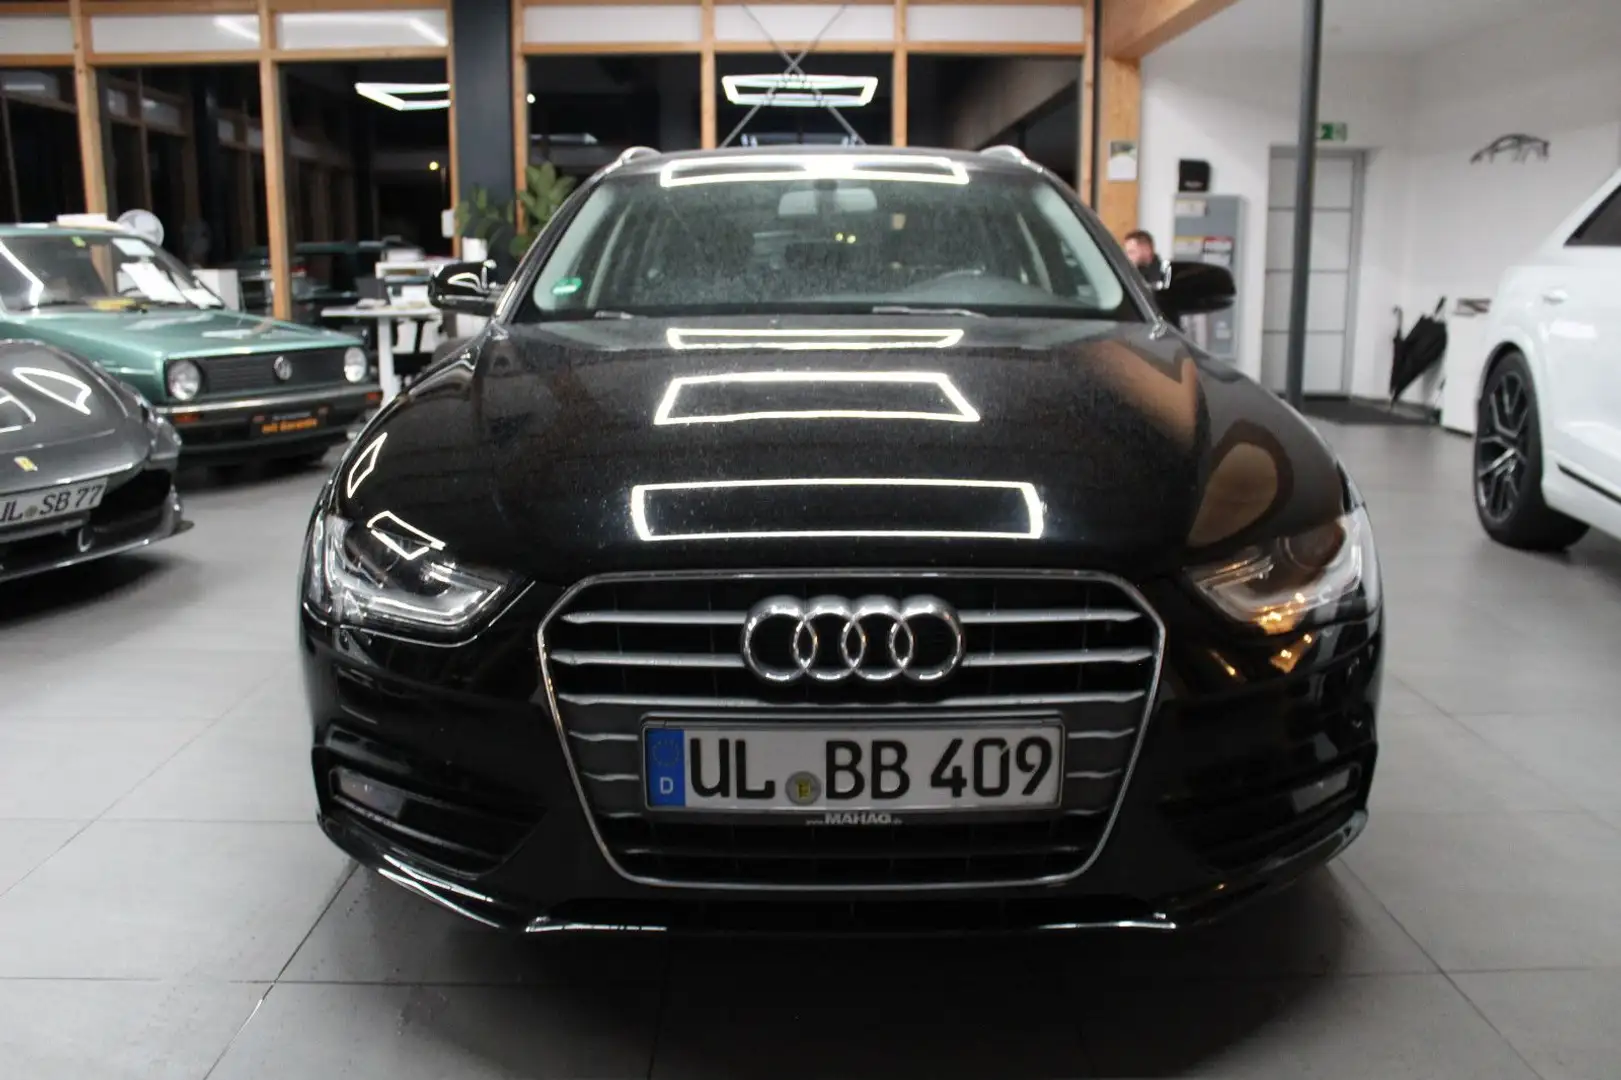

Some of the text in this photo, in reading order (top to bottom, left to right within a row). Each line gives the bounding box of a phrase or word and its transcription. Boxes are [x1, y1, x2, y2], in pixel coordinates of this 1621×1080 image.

[40, 492, 71, 515] SB
[75, 486, 103, 508] 77
[690, 736, 1052, 800] UL BB 409
[659, 776, 674, 795] D
